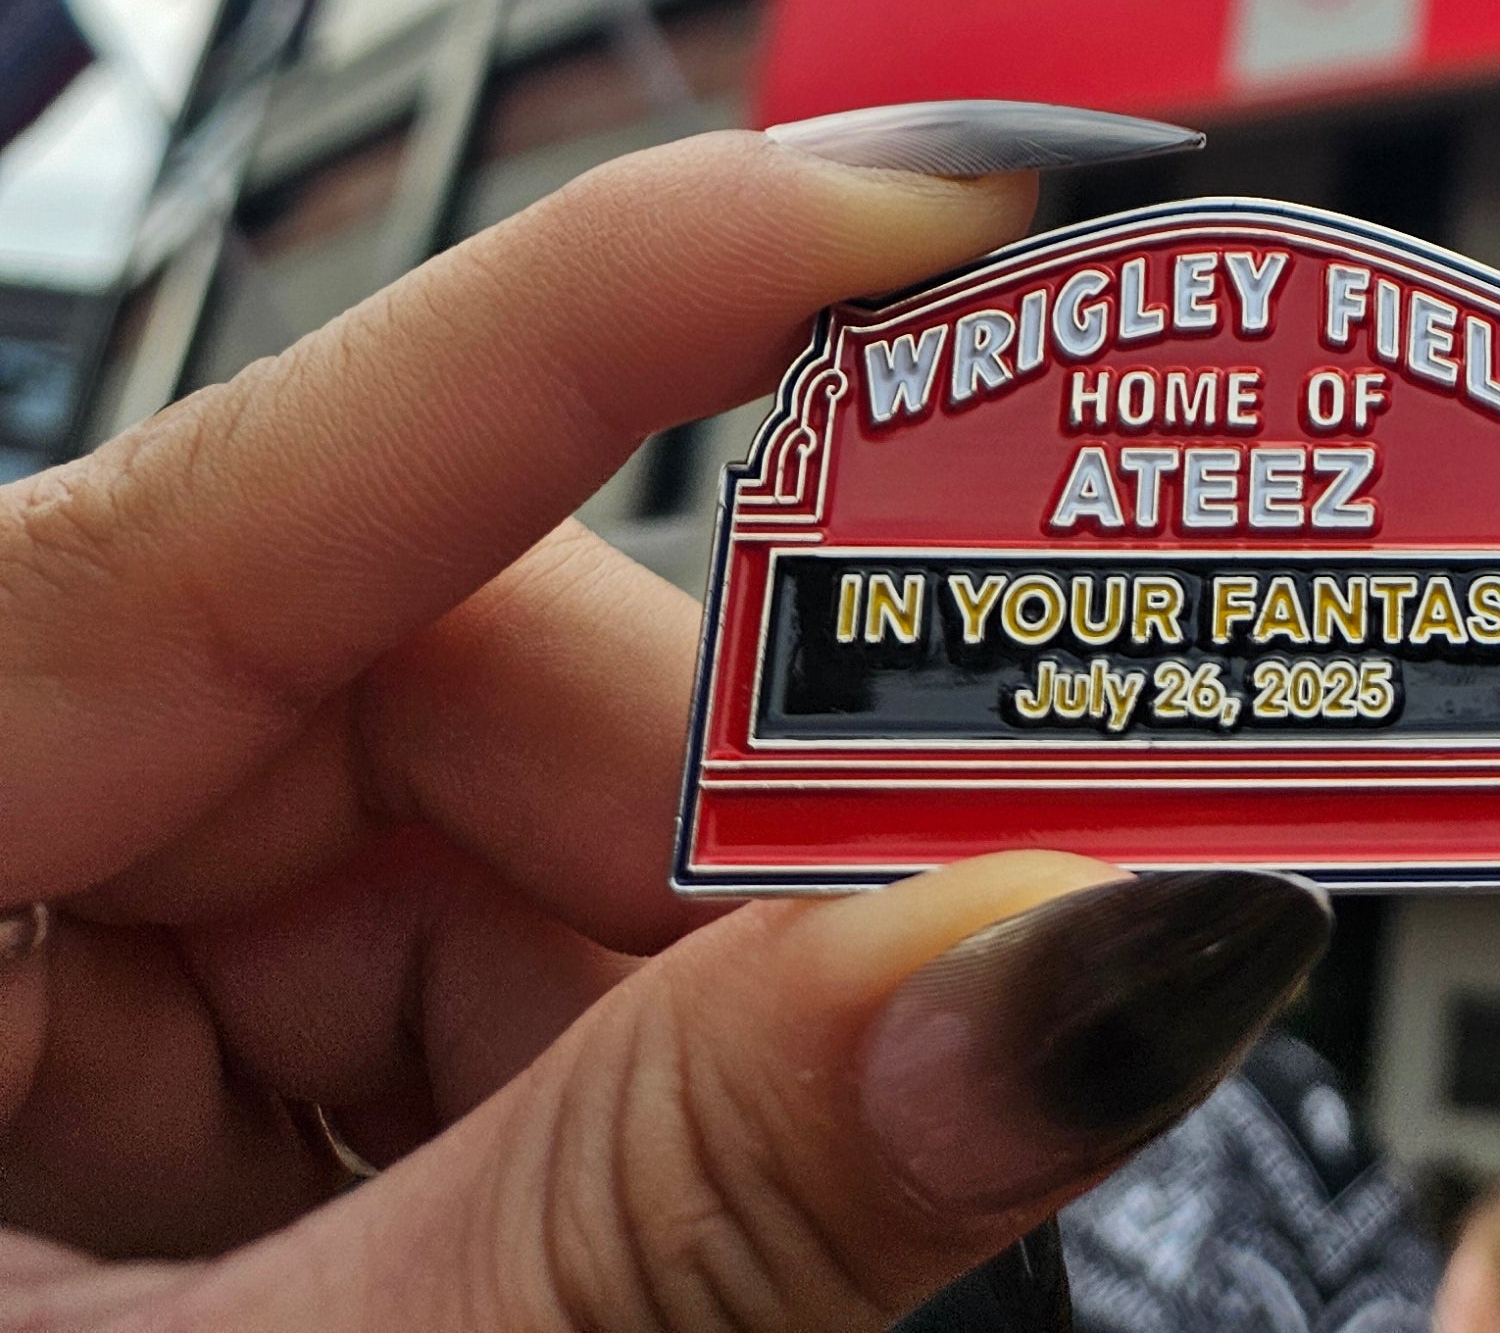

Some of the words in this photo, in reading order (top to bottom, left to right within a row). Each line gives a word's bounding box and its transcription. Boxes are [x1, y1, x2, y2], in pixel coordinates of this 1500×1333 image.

[862, 249, 1289, 425] WRIGLEY
[1070, 369, 1260, 429] HOME
[1307, 370, 1388, 429] OF
[1051, 445, 1378, 530] ATEEZ
[836, 573, 927, 645] IN
[950, 574, 1186, 644] YOUR
[1015, 659, 1148, 731] July
[1153, 660, 1238, 726] 26,
[1251, 660, 1395, 719] 2025
